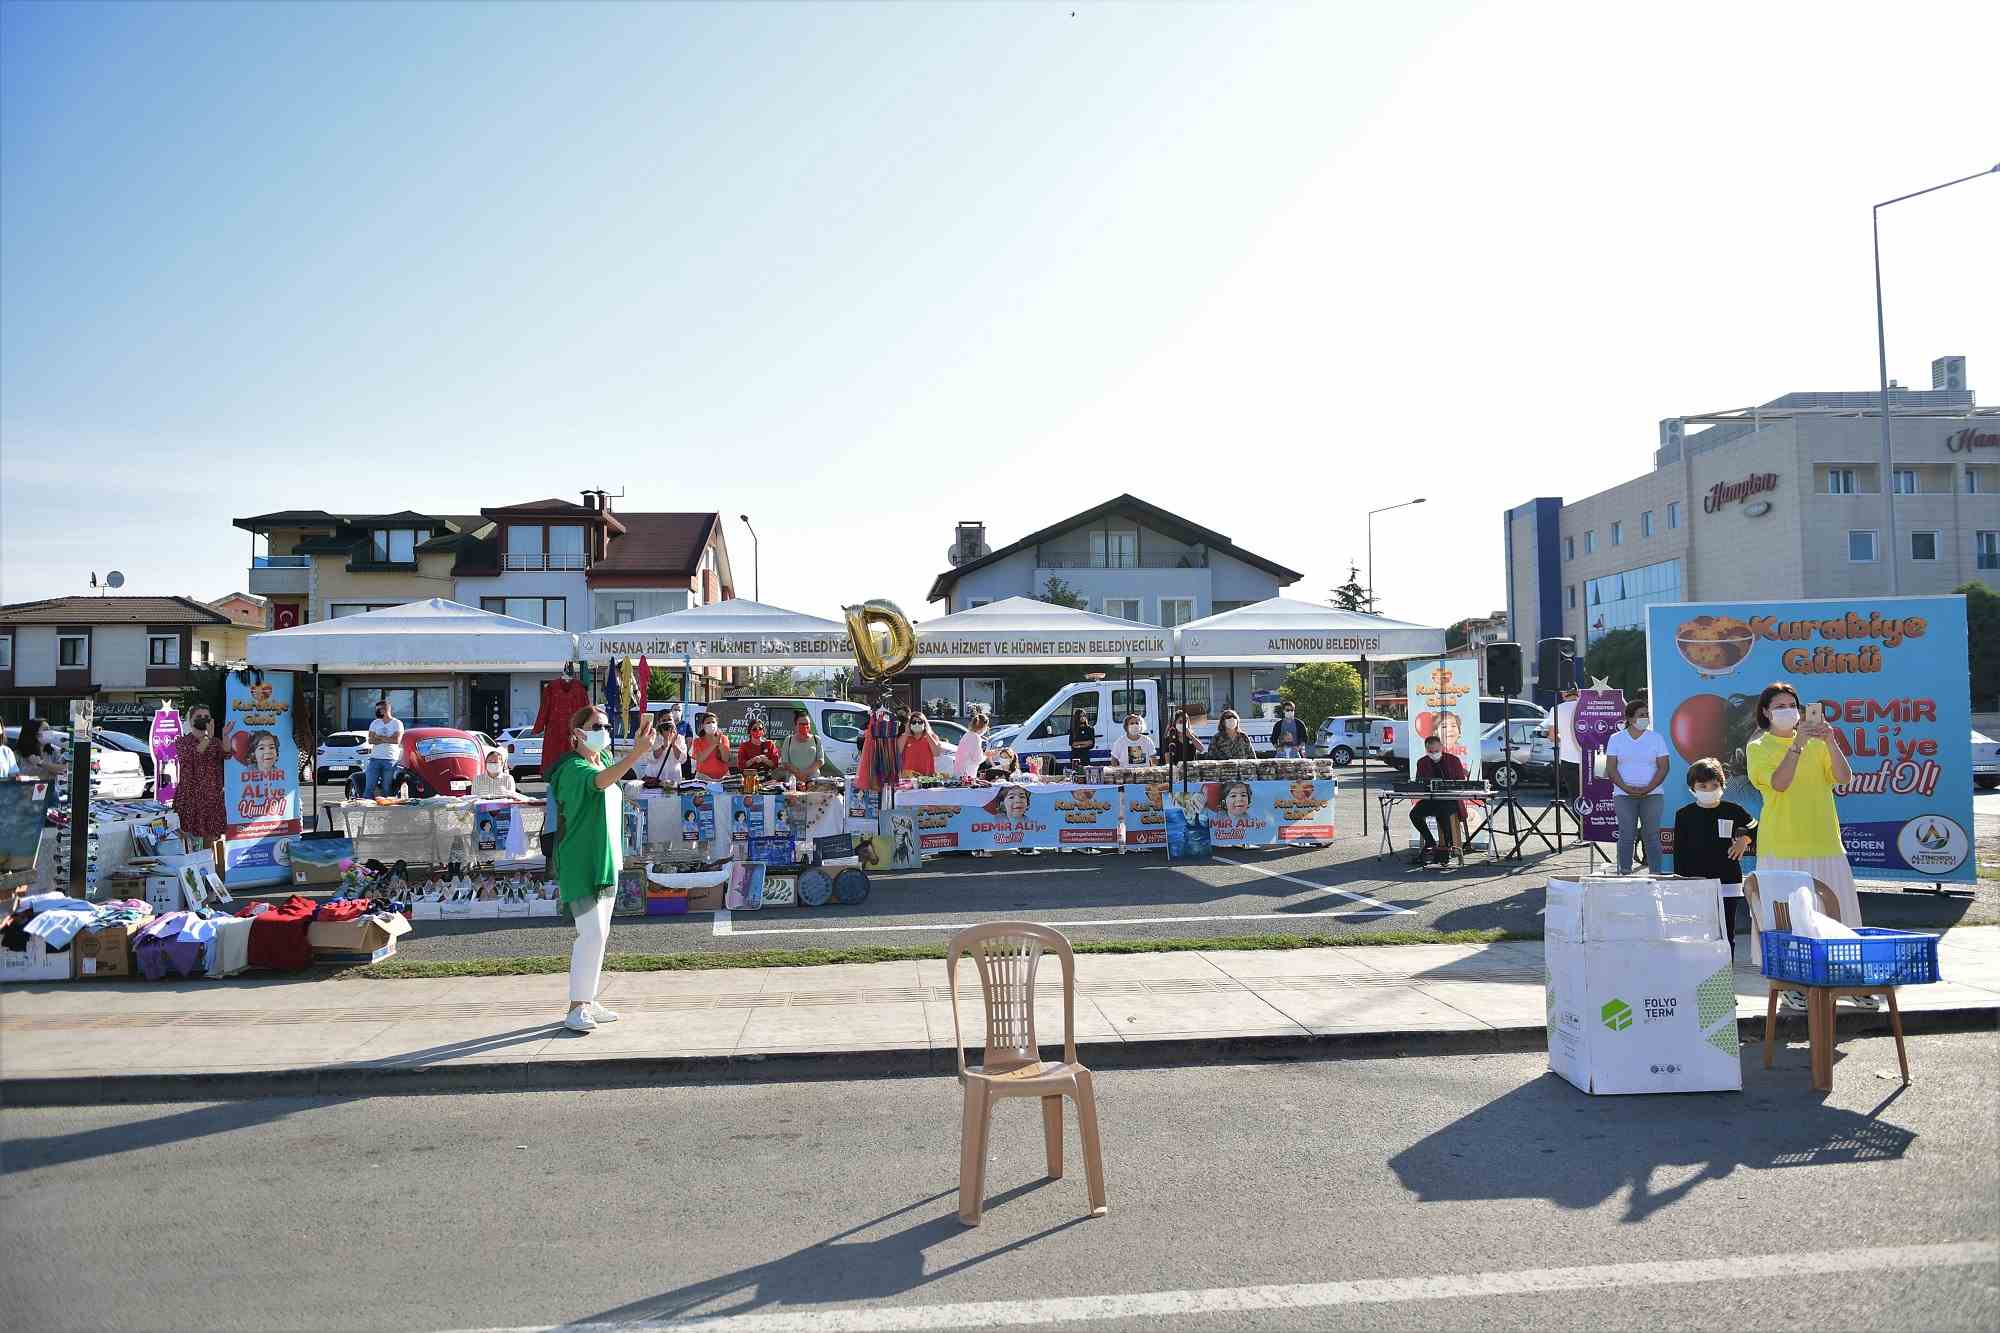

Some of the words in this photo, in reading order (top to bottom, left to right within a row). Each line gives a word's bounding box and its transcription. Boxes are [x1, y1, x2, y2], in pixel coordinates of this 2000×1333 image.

[1750, 611, 1927, 648] Kurabiye
[600, 637, 643, 654] İNSANA
[647, 637, 689, 654] HİZMET
[711, 636, 757, 653] HÜRMET
[952, 638, 991, 654] HİZMET
[995, 642, 1009, 654] VE
[1011, 638, 1056, 654] HÜRMET
[1058, 641, 1086, 653] EDEN
[1089, 635, 1164, 653] BELEDİYECİLİK
[1268, 638, 1323, 650] ALTINORDU
[1326, 633, 1380, 650] BELEDİYESİ
[1782, 645, 1882, 674] Günü
[1646, 1008, 1674, 1018] TERM
